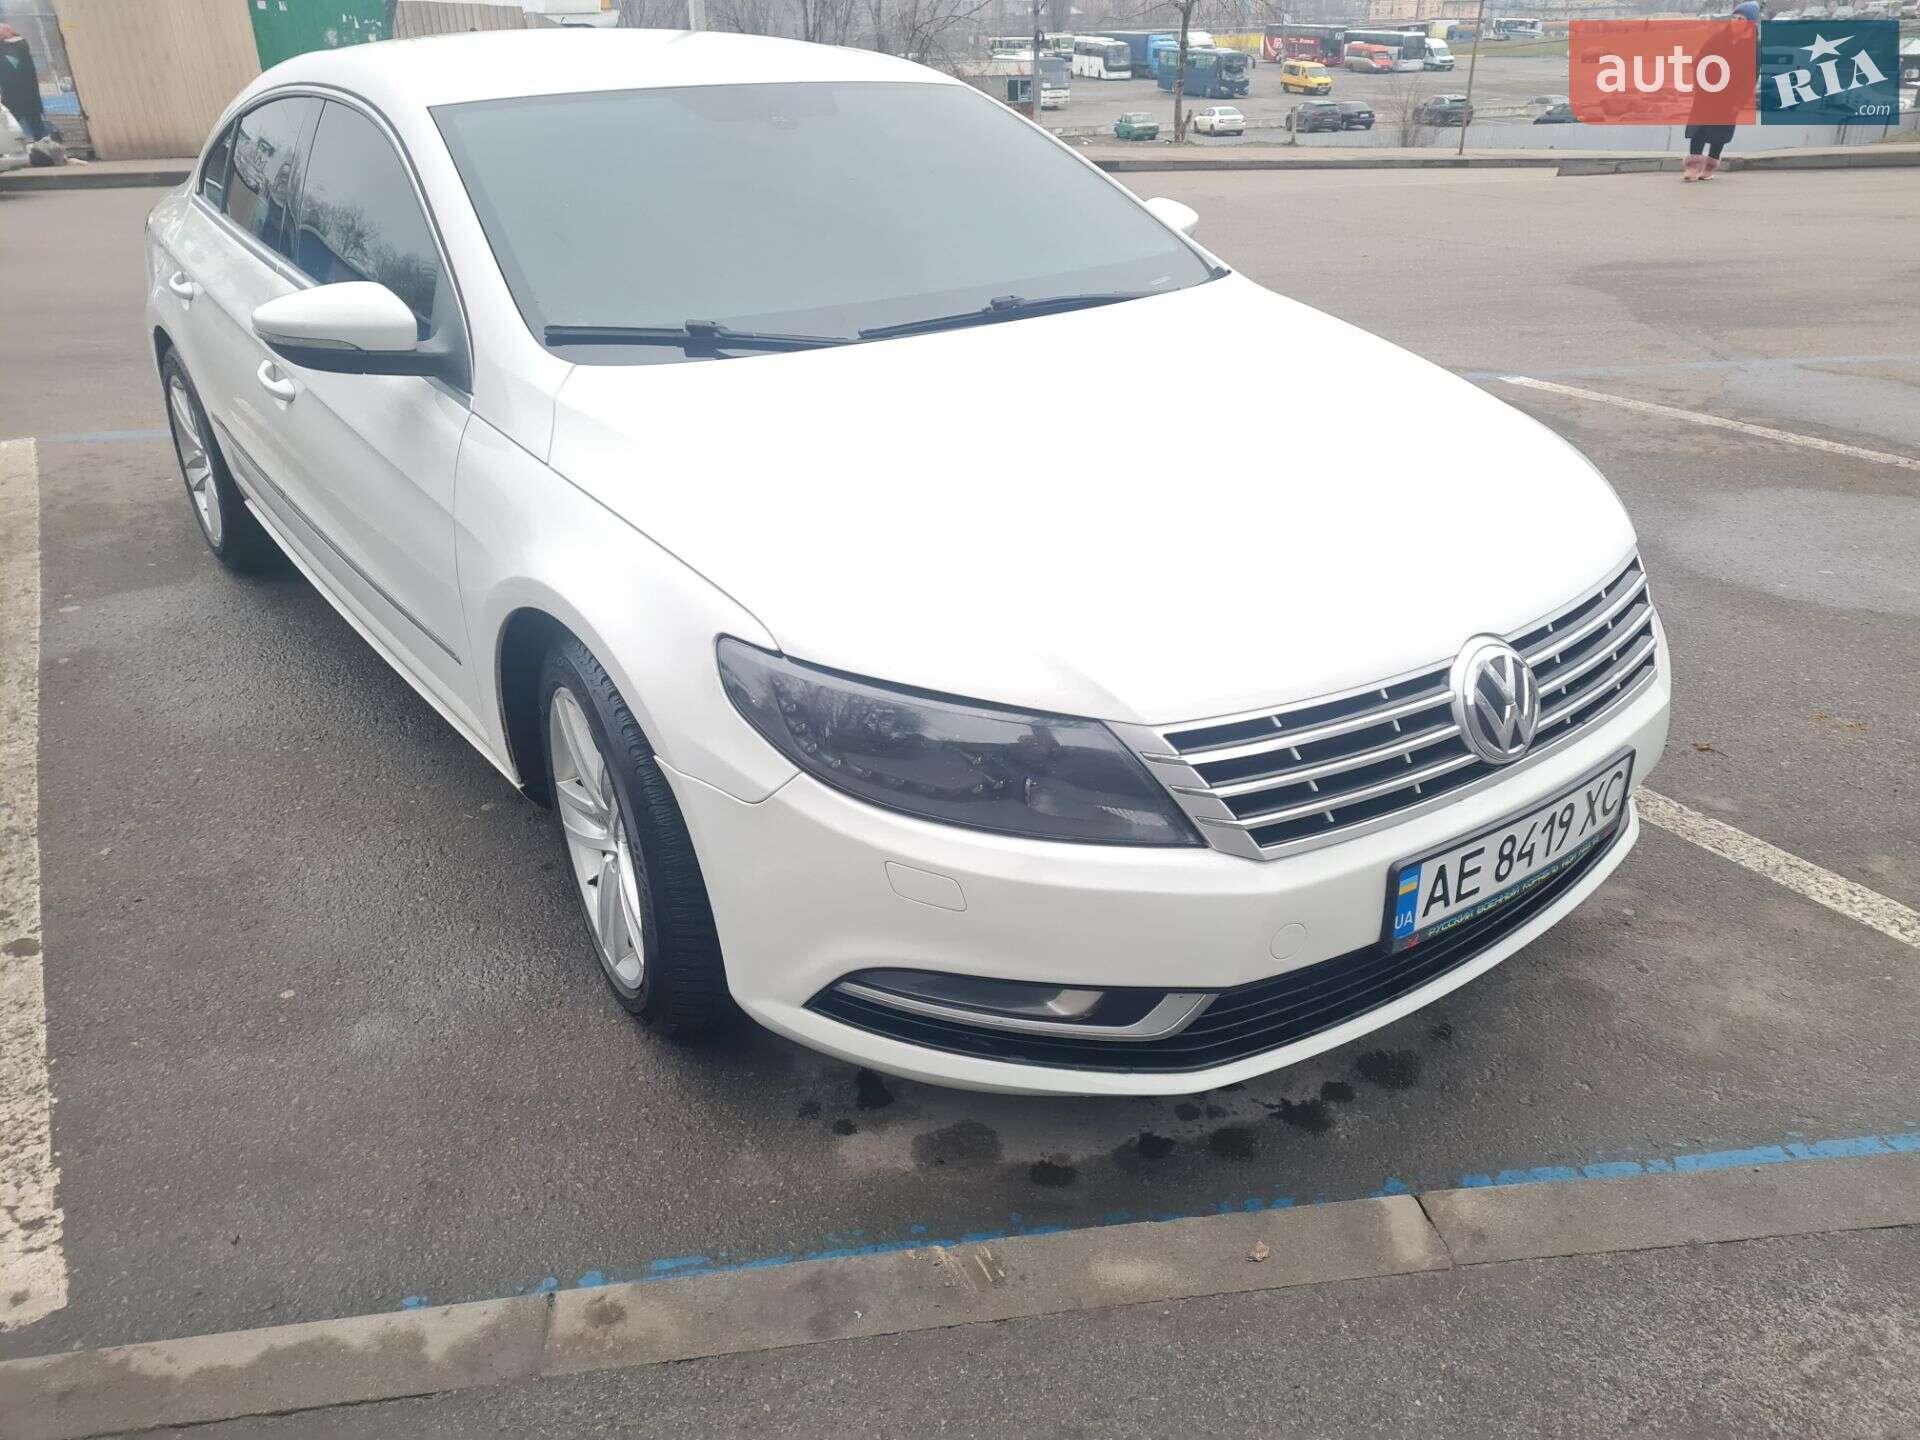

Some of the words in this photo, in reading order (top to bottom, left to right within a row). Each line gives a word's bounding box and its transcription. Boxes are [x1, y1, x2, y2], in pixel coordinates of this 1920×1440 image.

[1423, 846, 1486, 918] AE
[1494, 802, 1575, 883] 8419
[1579, 770, 1623, 837] XC
[1394, 914, 1413, 930] UA
